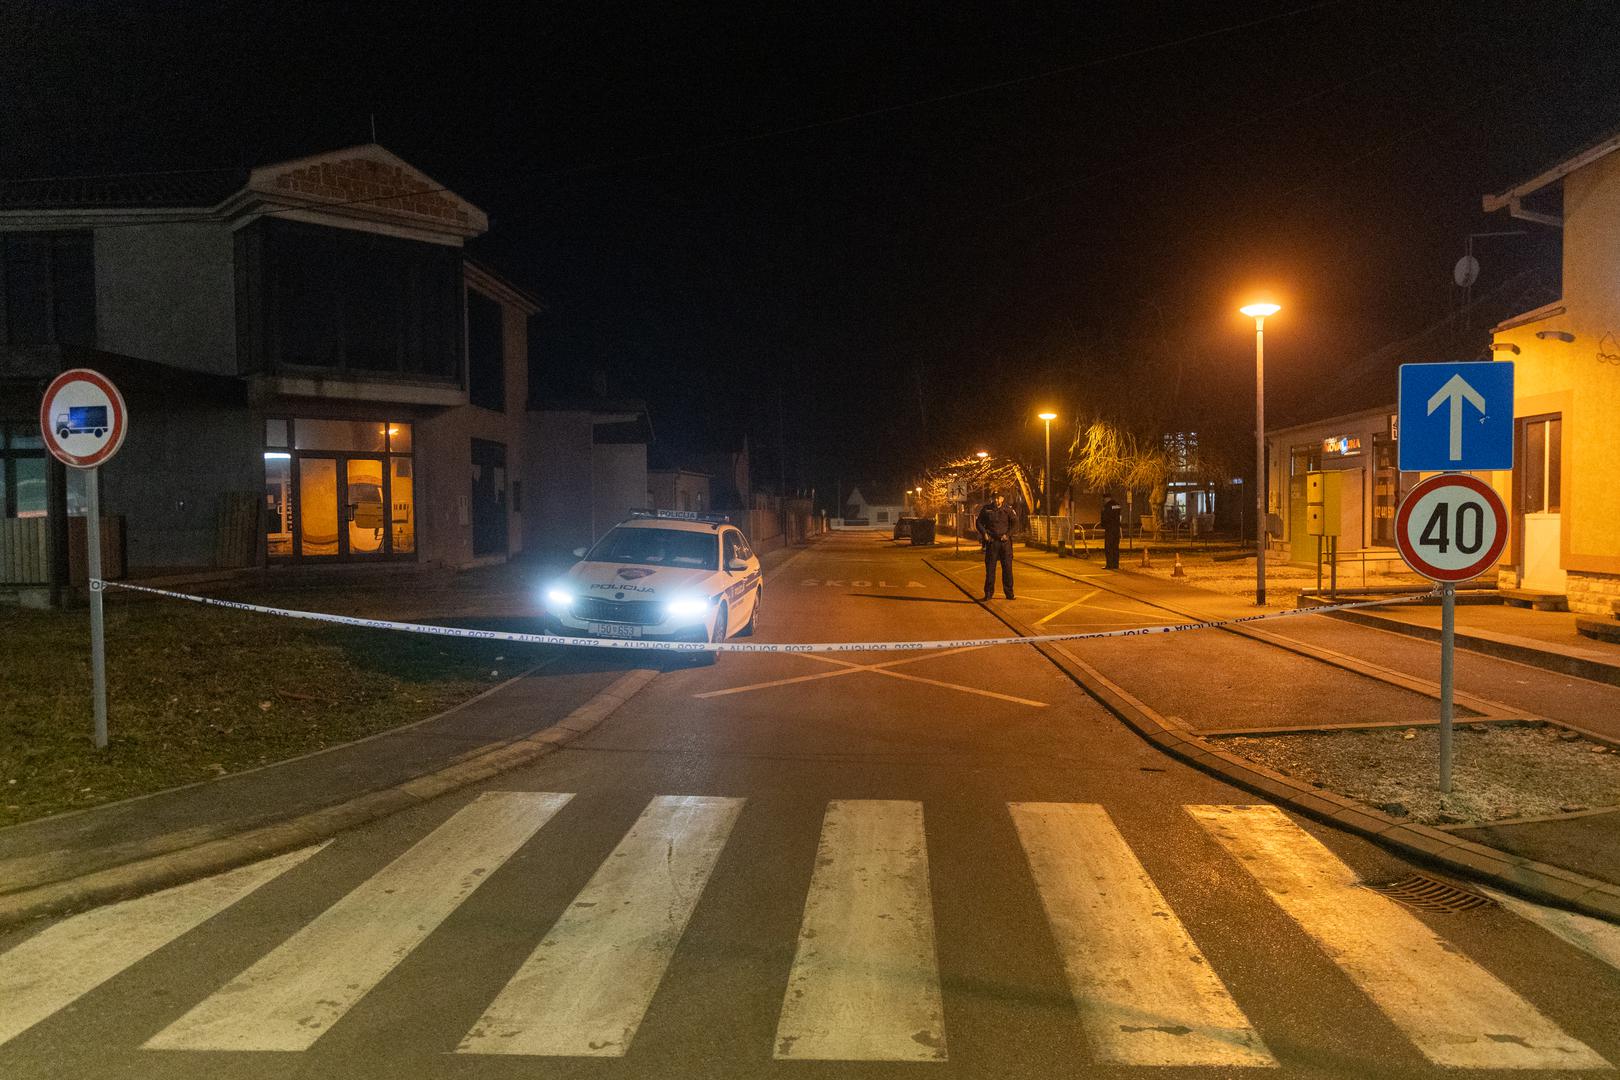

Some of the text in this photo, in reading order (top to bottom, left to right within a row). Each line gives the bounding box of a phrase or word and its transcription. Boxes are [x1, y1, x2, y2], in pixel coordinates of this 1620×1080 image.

[660, 510, 696, 519] POLICIJA
[1419, 501, 1484, 555] 40
[590, 583, 656, 593] POLICIJA
